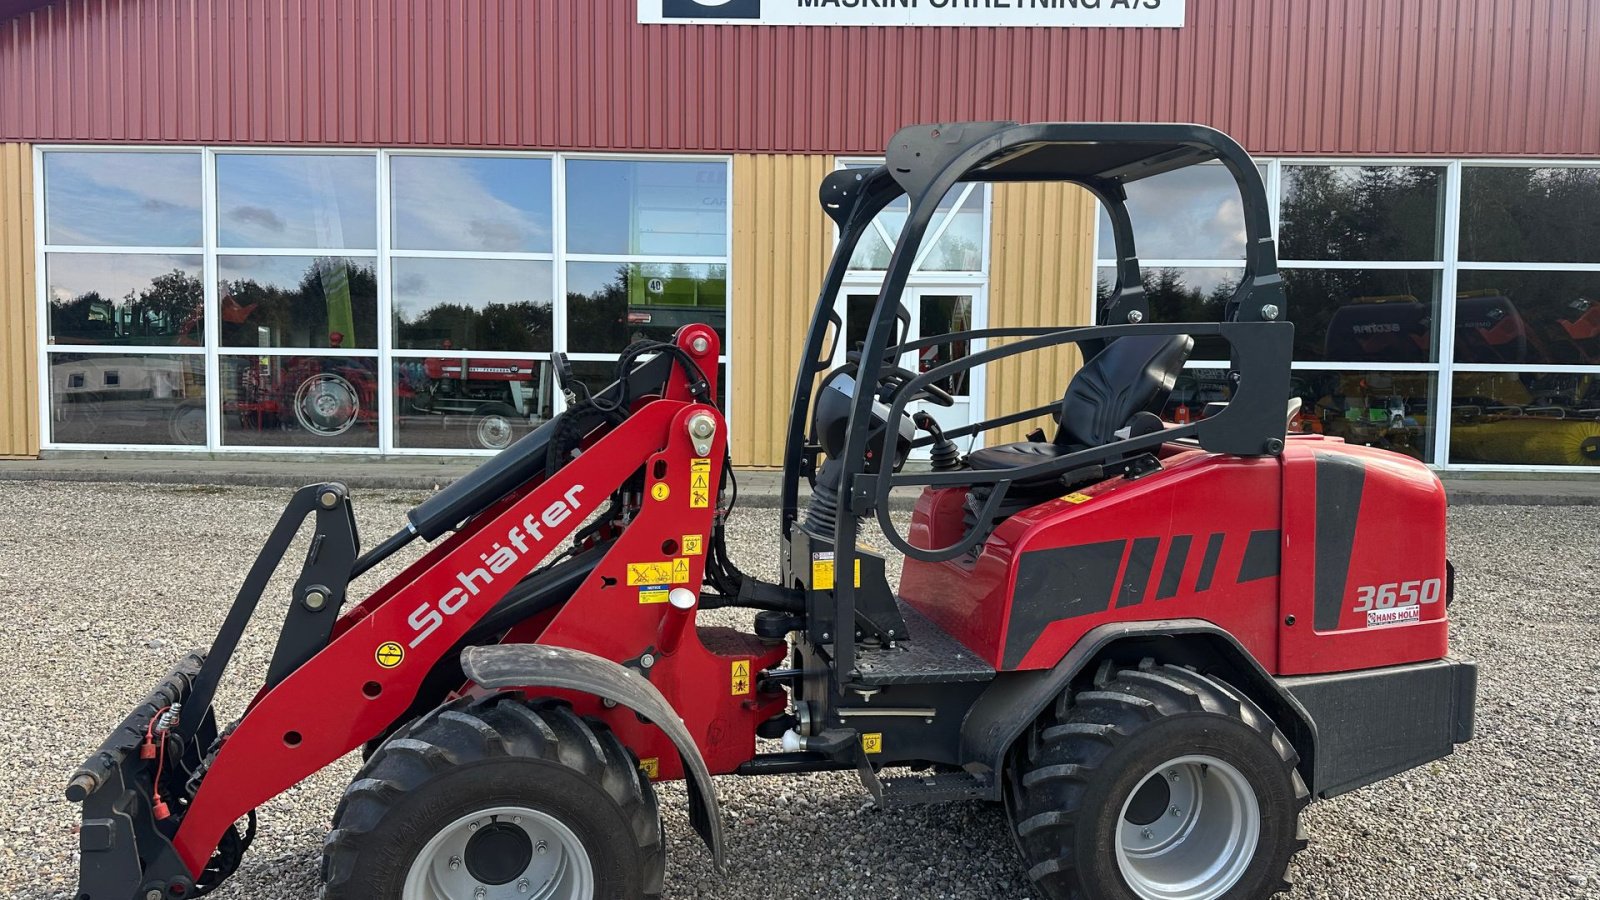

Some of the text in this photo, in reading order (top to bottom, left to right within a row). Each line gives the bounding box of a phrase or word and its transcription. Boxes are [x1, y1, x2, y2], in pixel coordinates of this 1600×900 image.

[650, 280, 661, 291] 40
[407, 484, 585, 649] Schäffer
[1353, 578, 1441, 612] 3650
[1376, 610, 1419, 622] HANS HOLM
